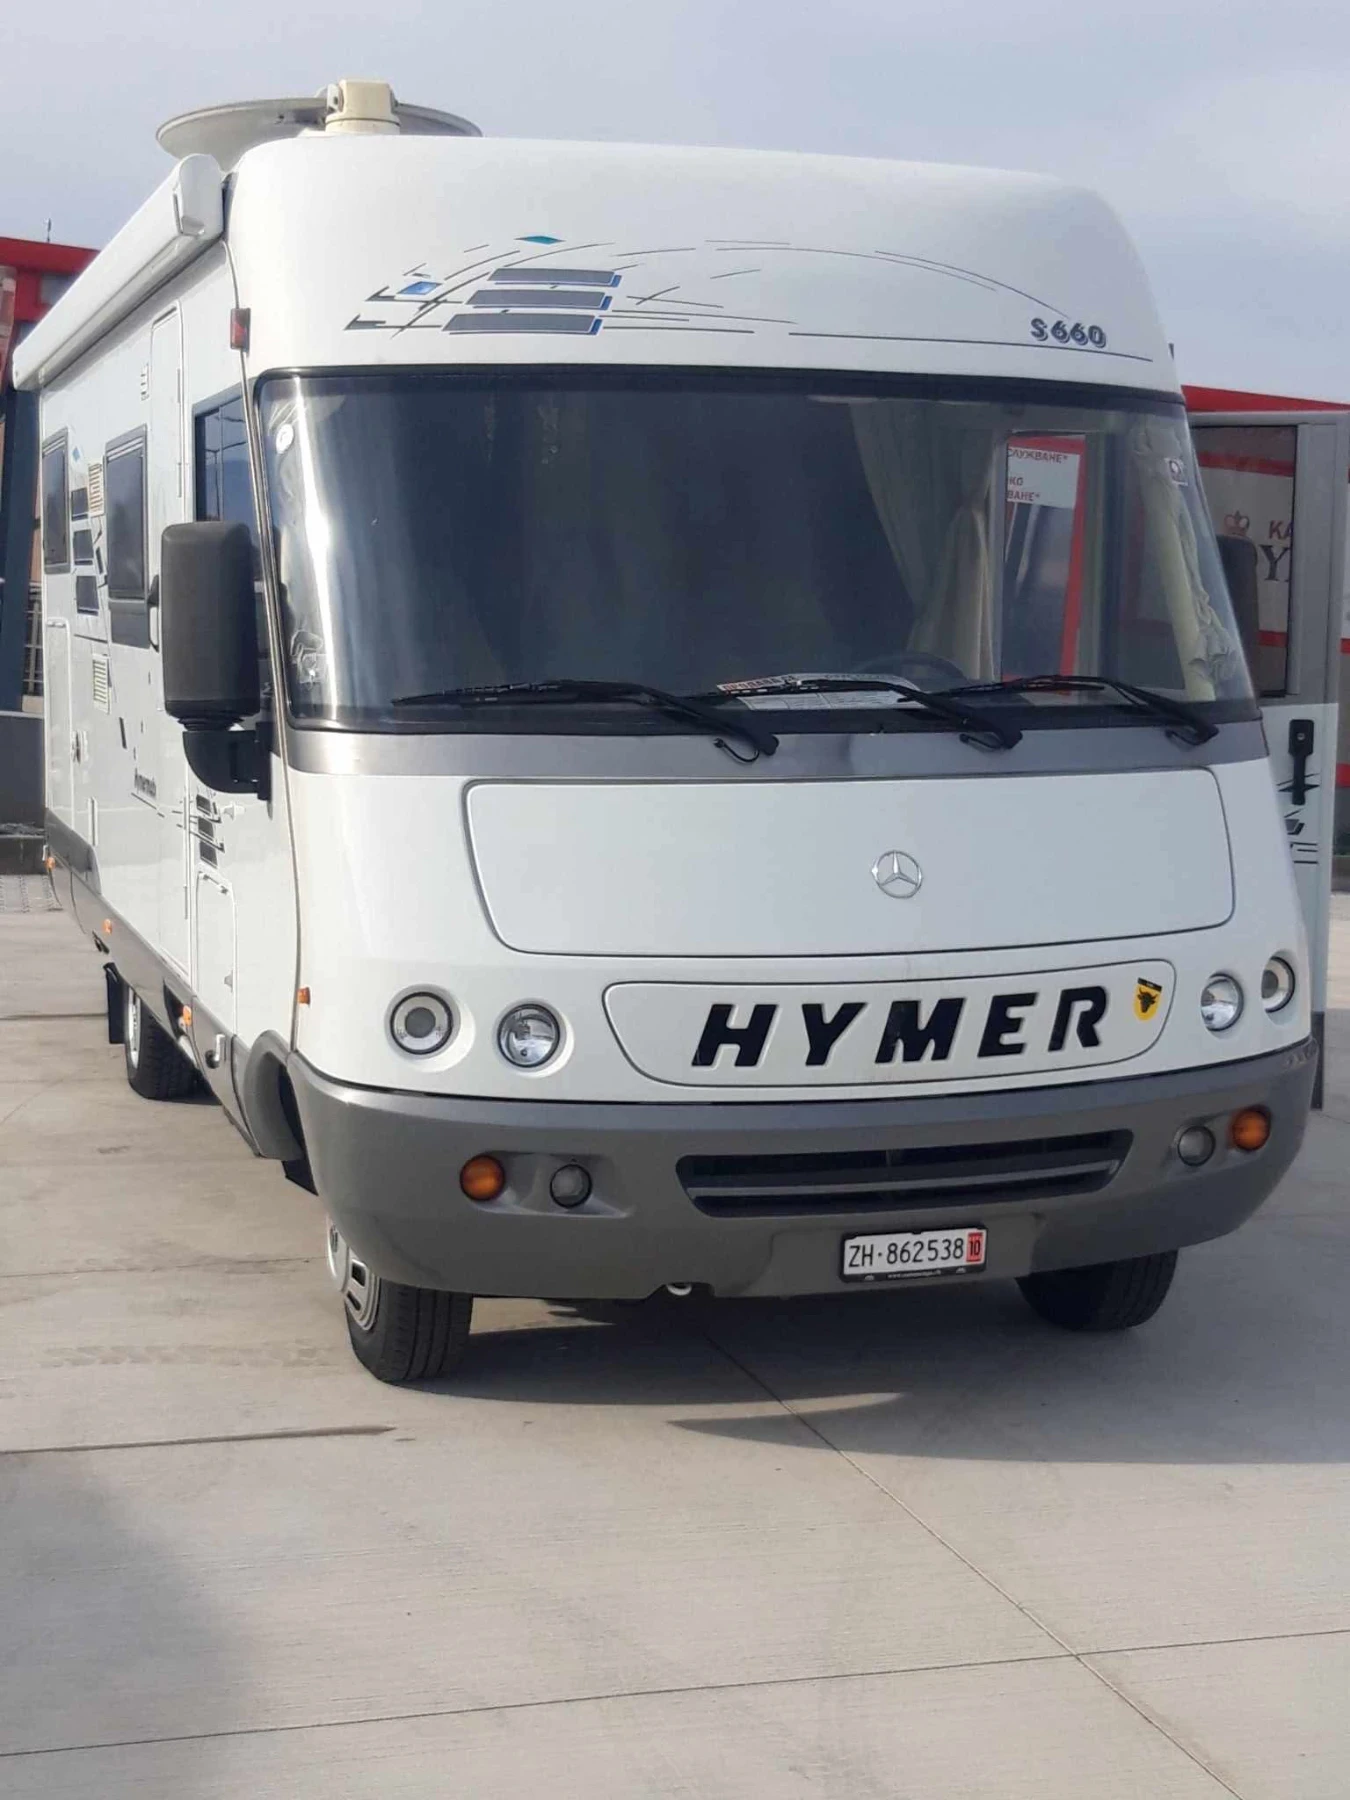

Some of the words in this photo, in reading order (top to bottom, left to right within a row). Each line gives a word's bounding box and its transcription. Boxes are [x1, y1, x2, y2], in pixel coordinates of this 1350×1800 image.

[1030, 317, 1107, 349] S660
[1258, 544, 1291, 582] Y
[691, 985, 1108, 1067] HYMER
